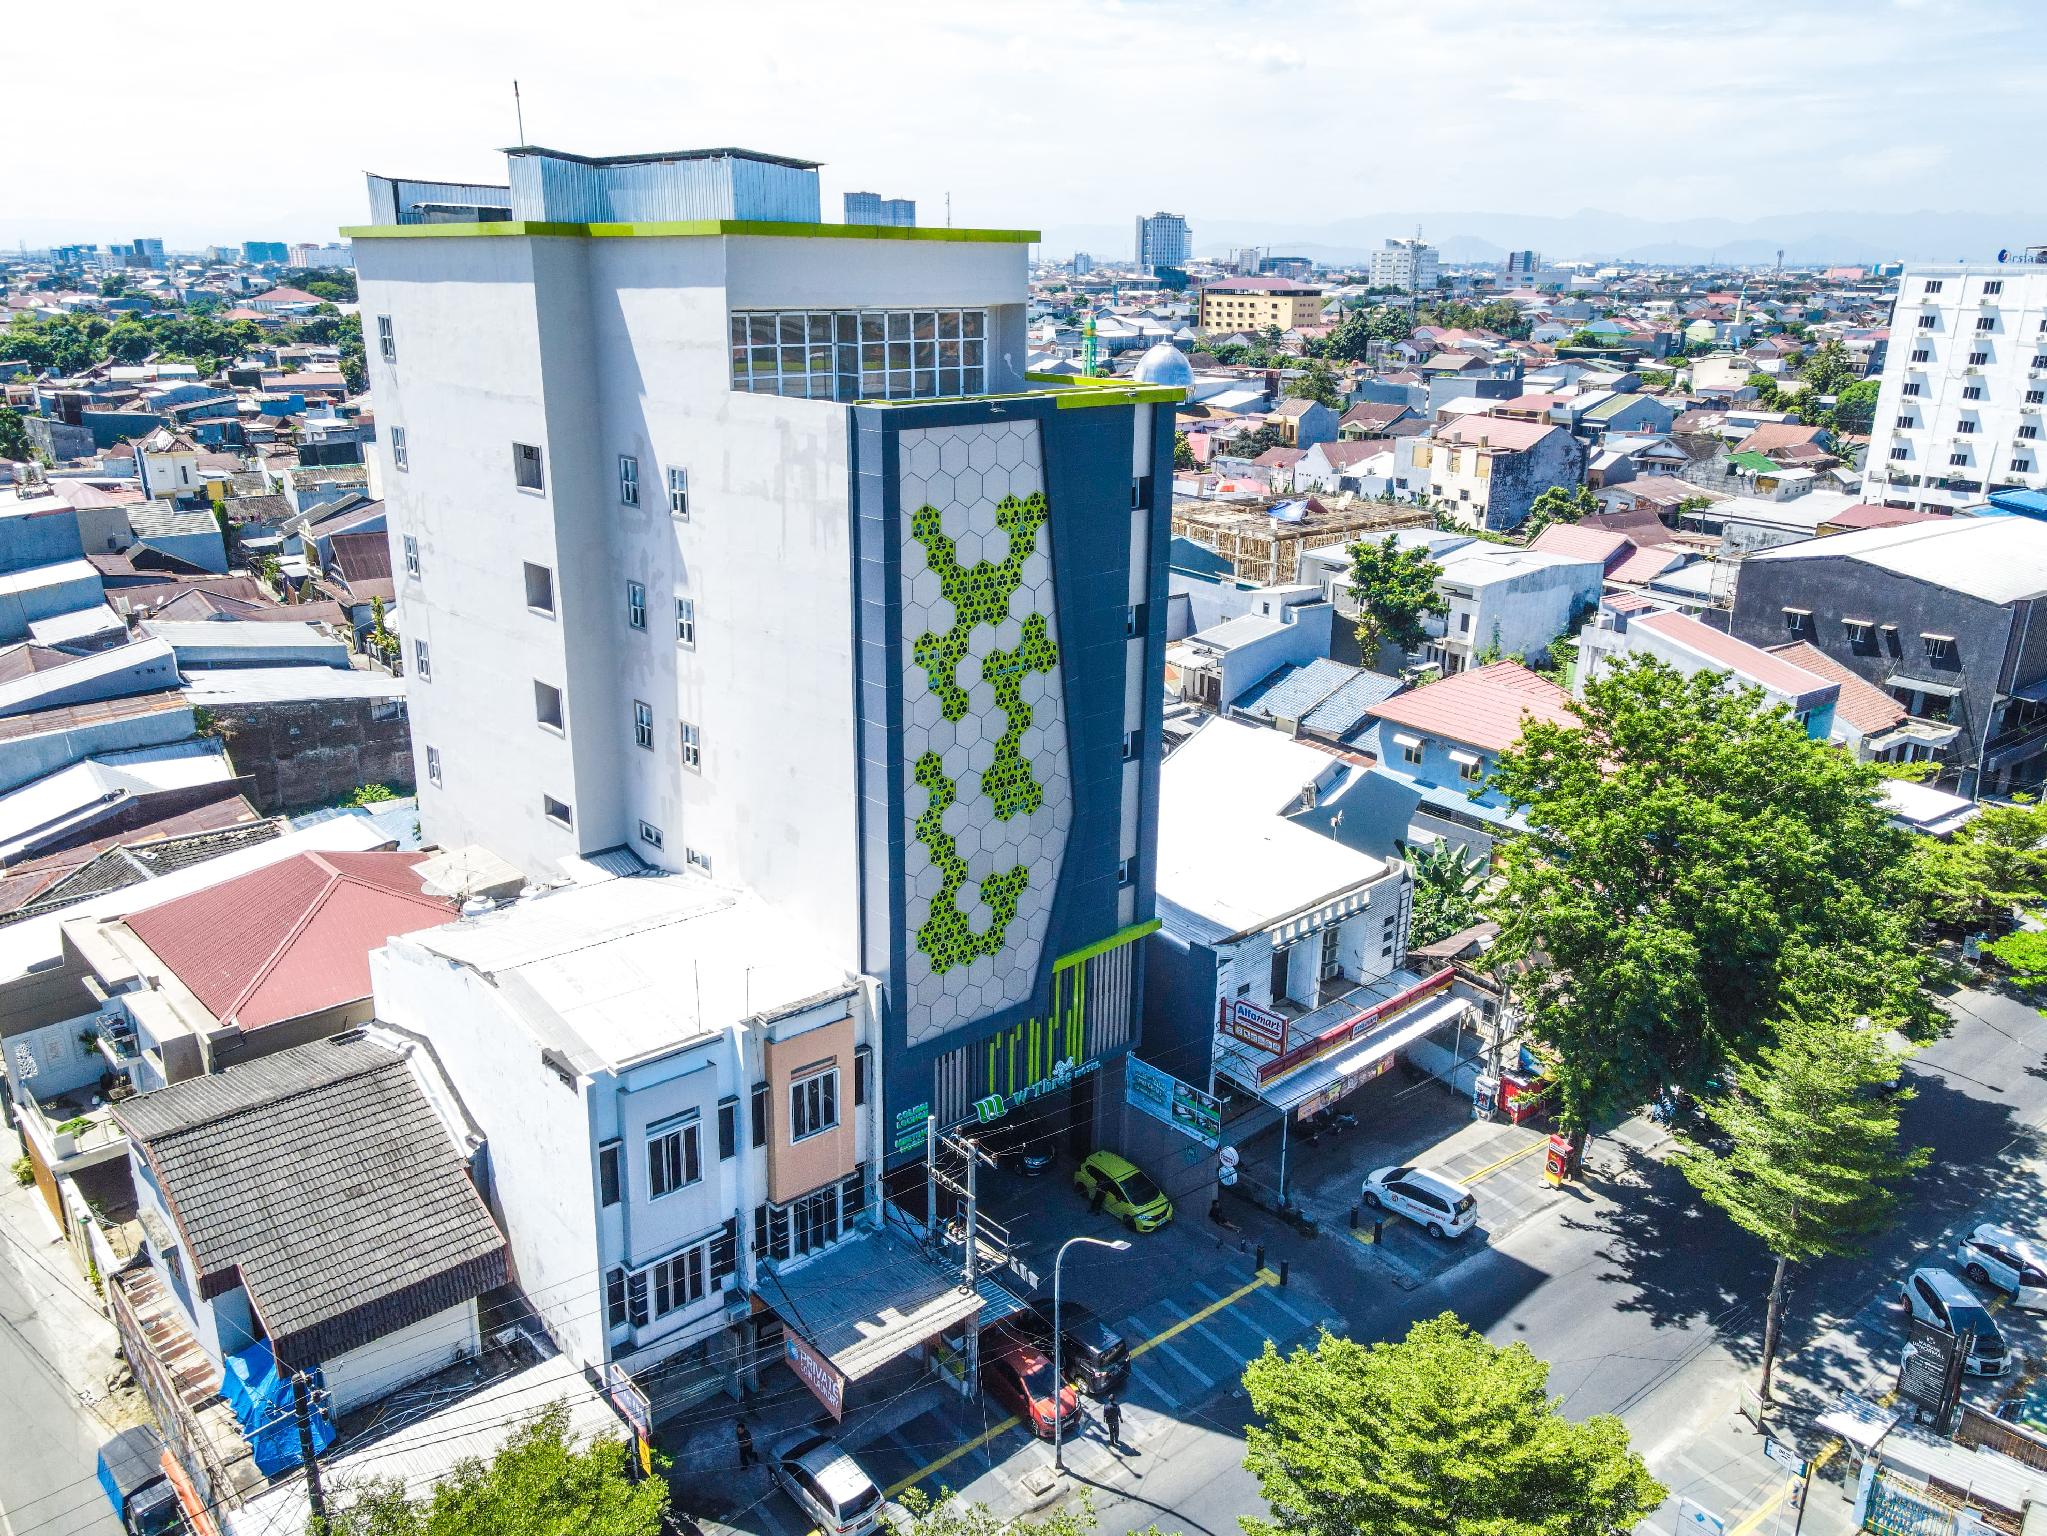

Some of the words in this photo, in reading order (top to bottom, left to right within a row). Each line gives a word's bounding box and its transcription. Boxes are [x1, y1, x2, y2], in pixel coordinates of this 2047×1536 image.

[1237, 1005, 1280, 1031] Alfamart
[1032, 1072, 1072, 1097] Three
[800, 1349, 839, 1398] PRIVATE
[813, 1375, 839, 1408] LAUNDRY
